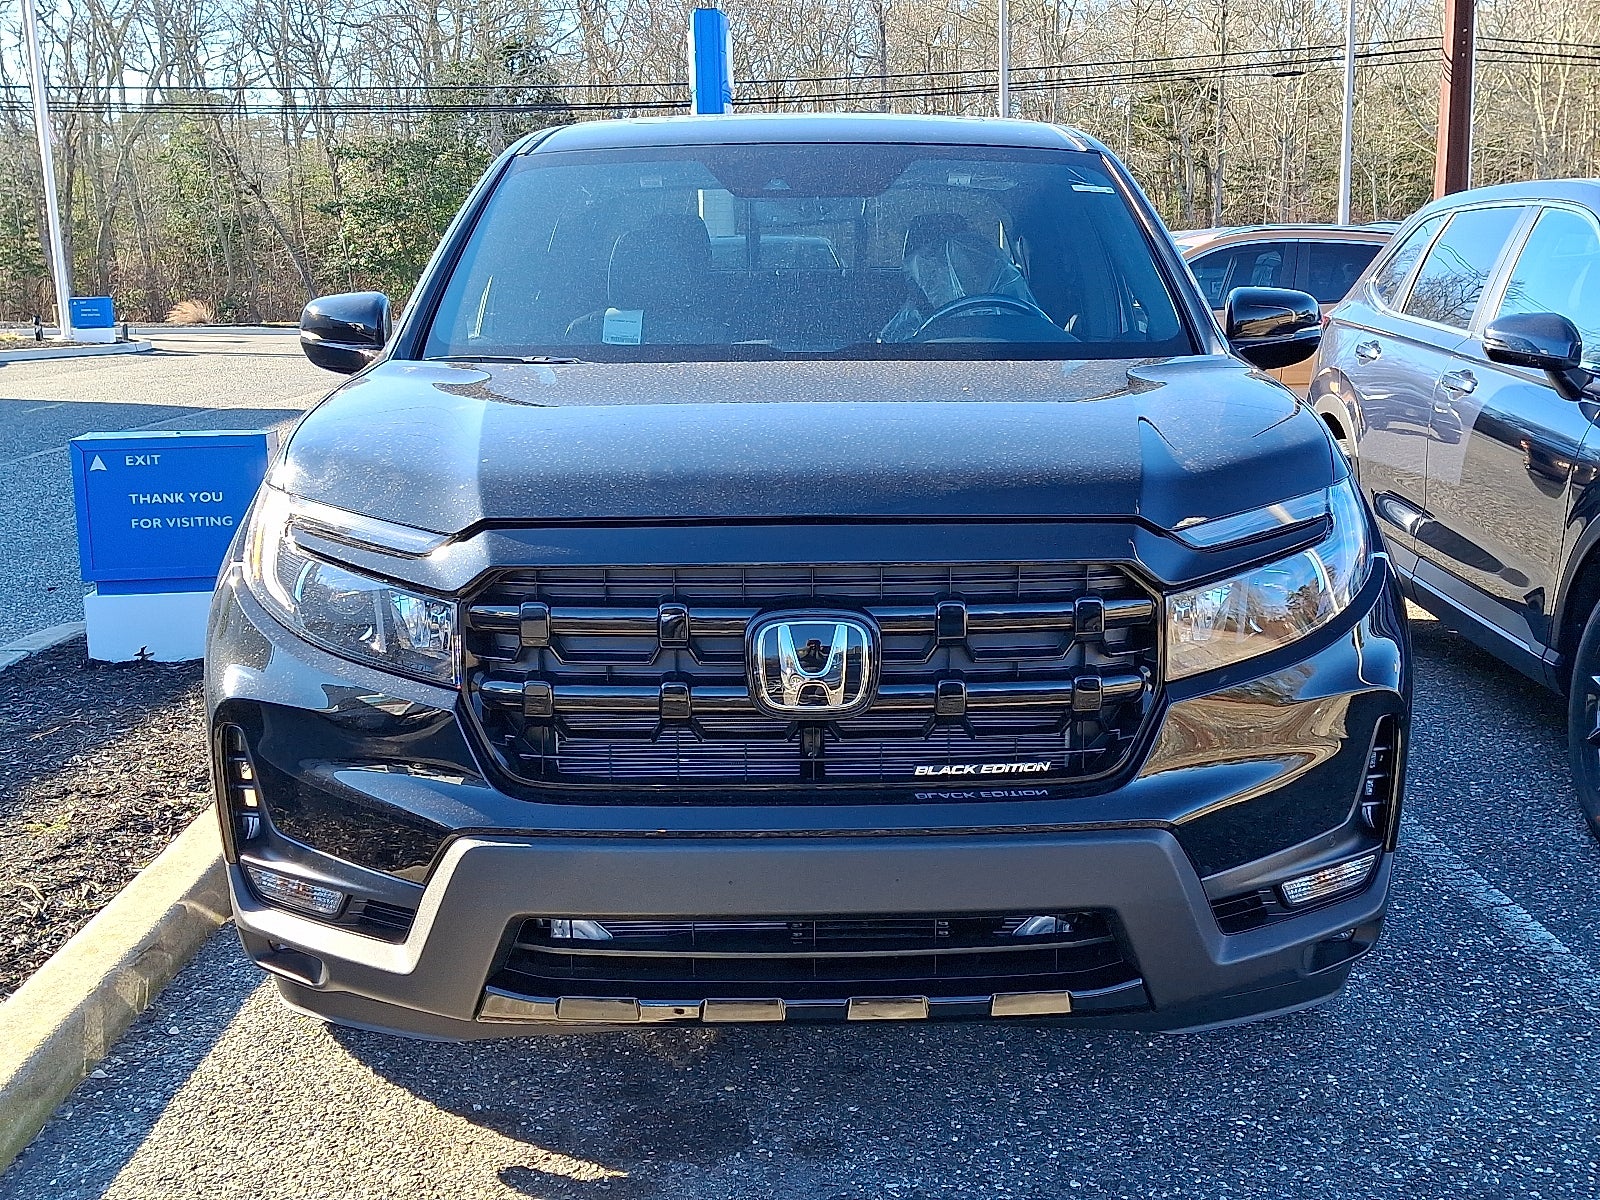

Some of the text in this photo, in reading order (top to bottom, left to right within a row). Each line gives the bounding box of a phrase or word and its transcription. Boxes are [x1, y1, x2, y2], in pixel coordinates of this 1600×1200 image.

[125, 454, 161, 466] EXIT
[128, 491, 223, 505] THANK YOU
[131, 516, 233, 529] FOR VISITING
[914, 761, 1052, 776] BLACK EDITION
